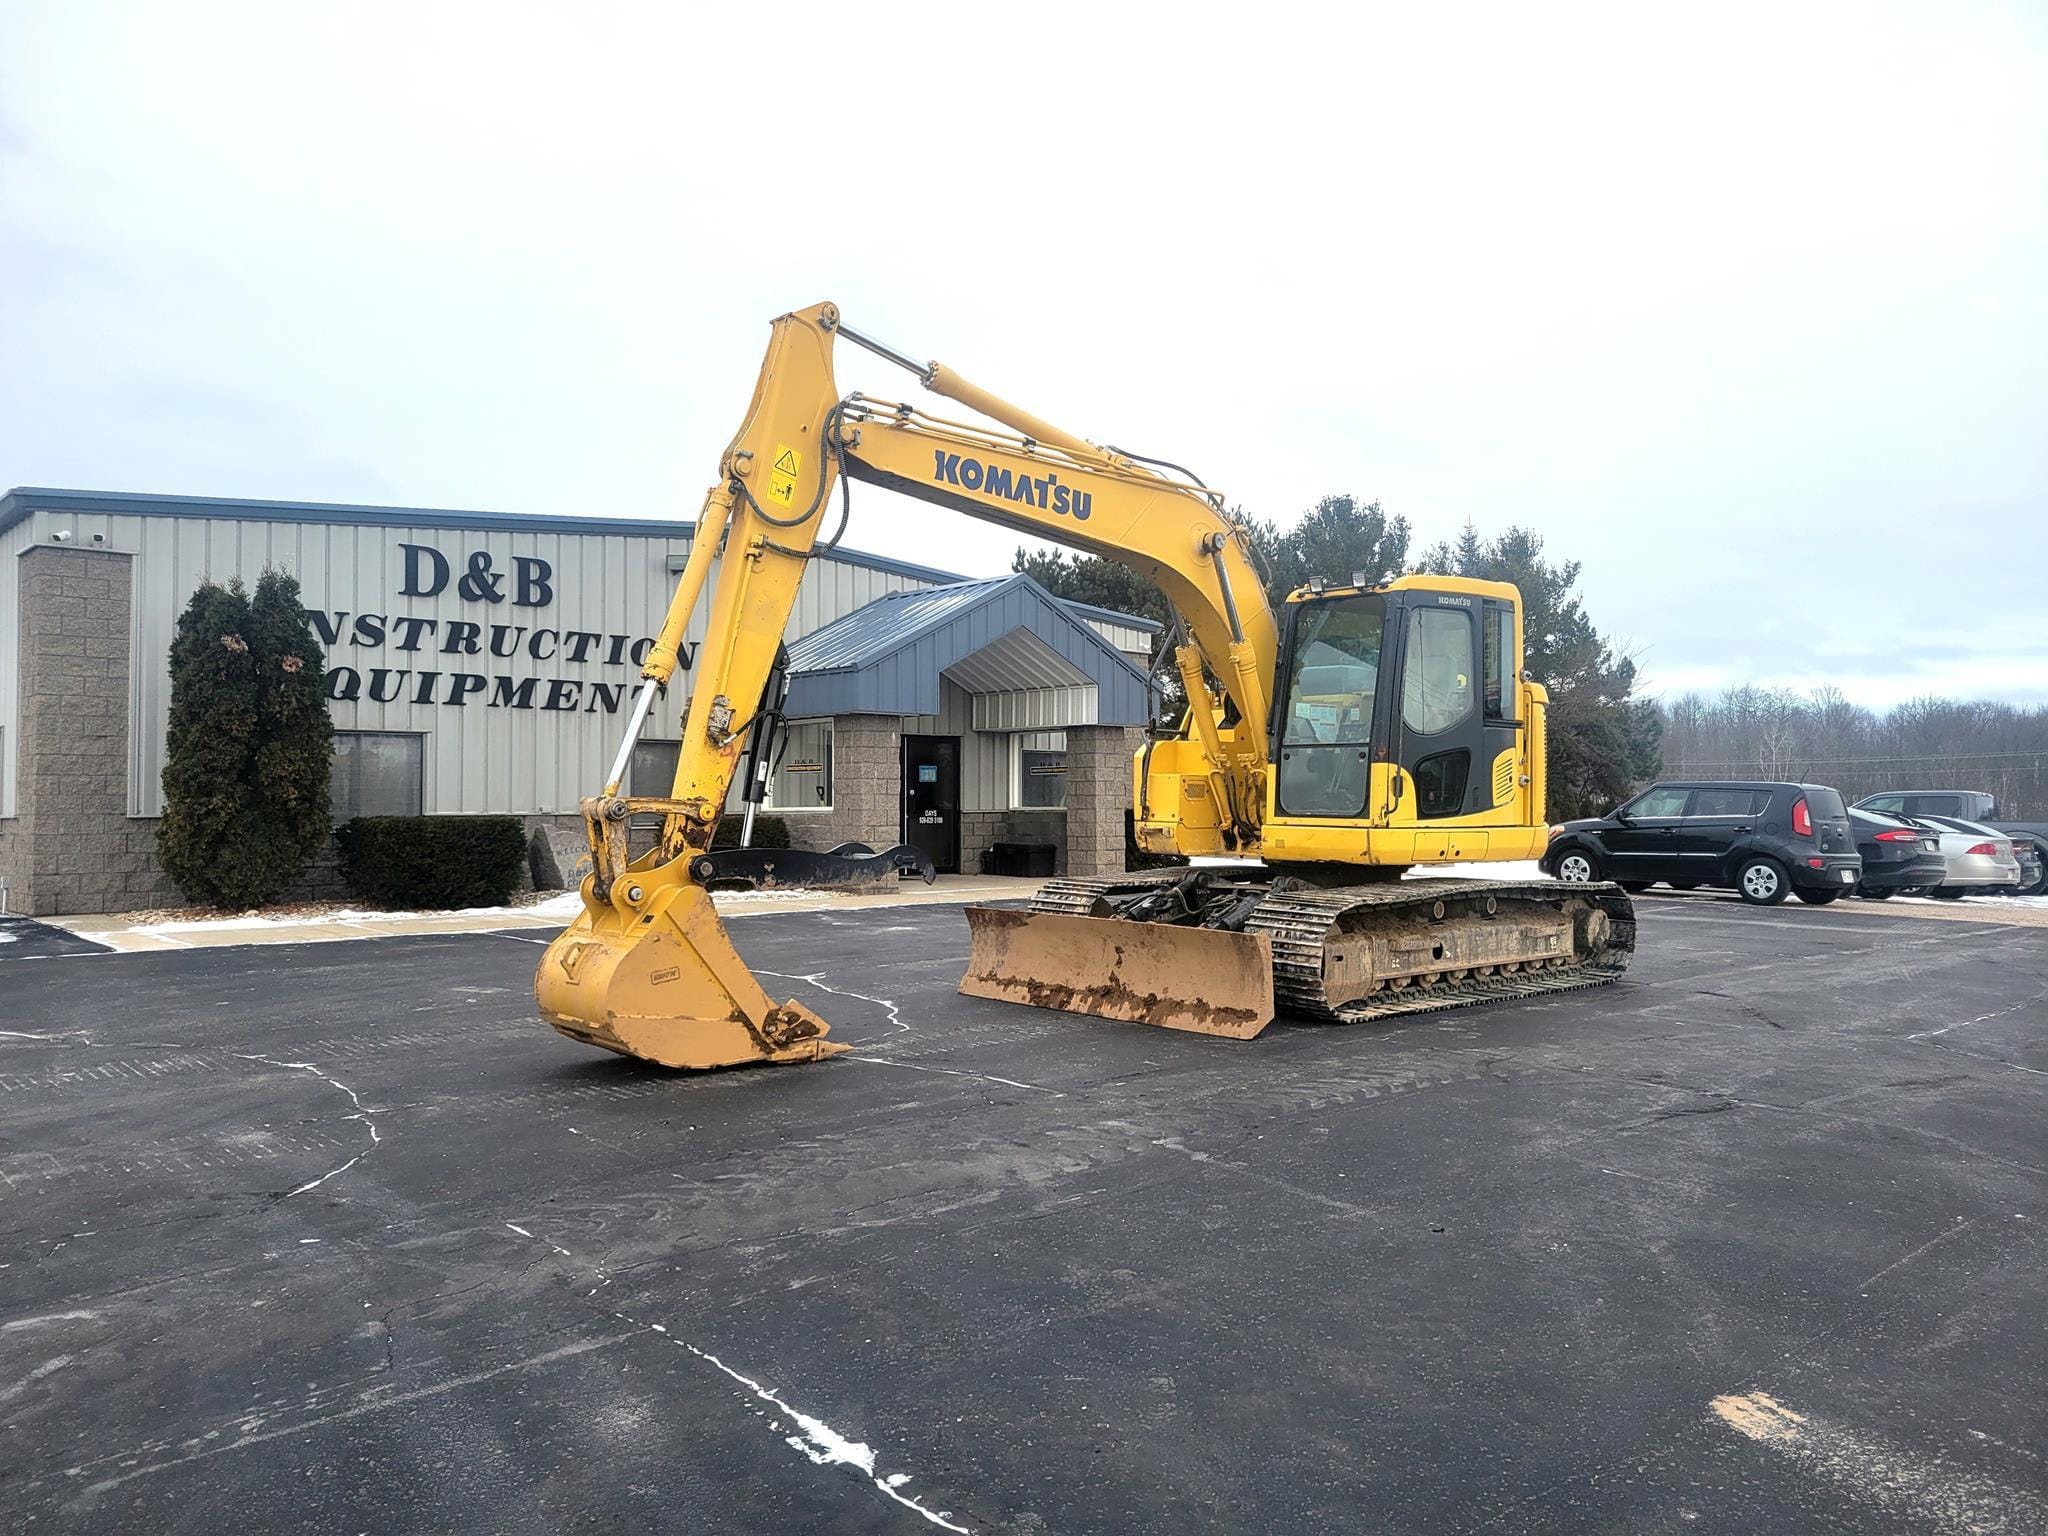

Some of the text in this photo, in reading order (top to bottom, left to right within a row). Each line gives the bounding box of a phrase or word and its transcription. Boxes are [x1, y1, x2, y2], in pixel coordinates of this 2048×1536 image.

[934, 449, 1093, 521] KOMATSU
[1438, 596, 1471, 607] KOMATSU
[303, 609, 701, 671] NSTRUCTION
[325, 666, 668, 716] QUIPMENT
[556, 845, 588, 855] WELCO
